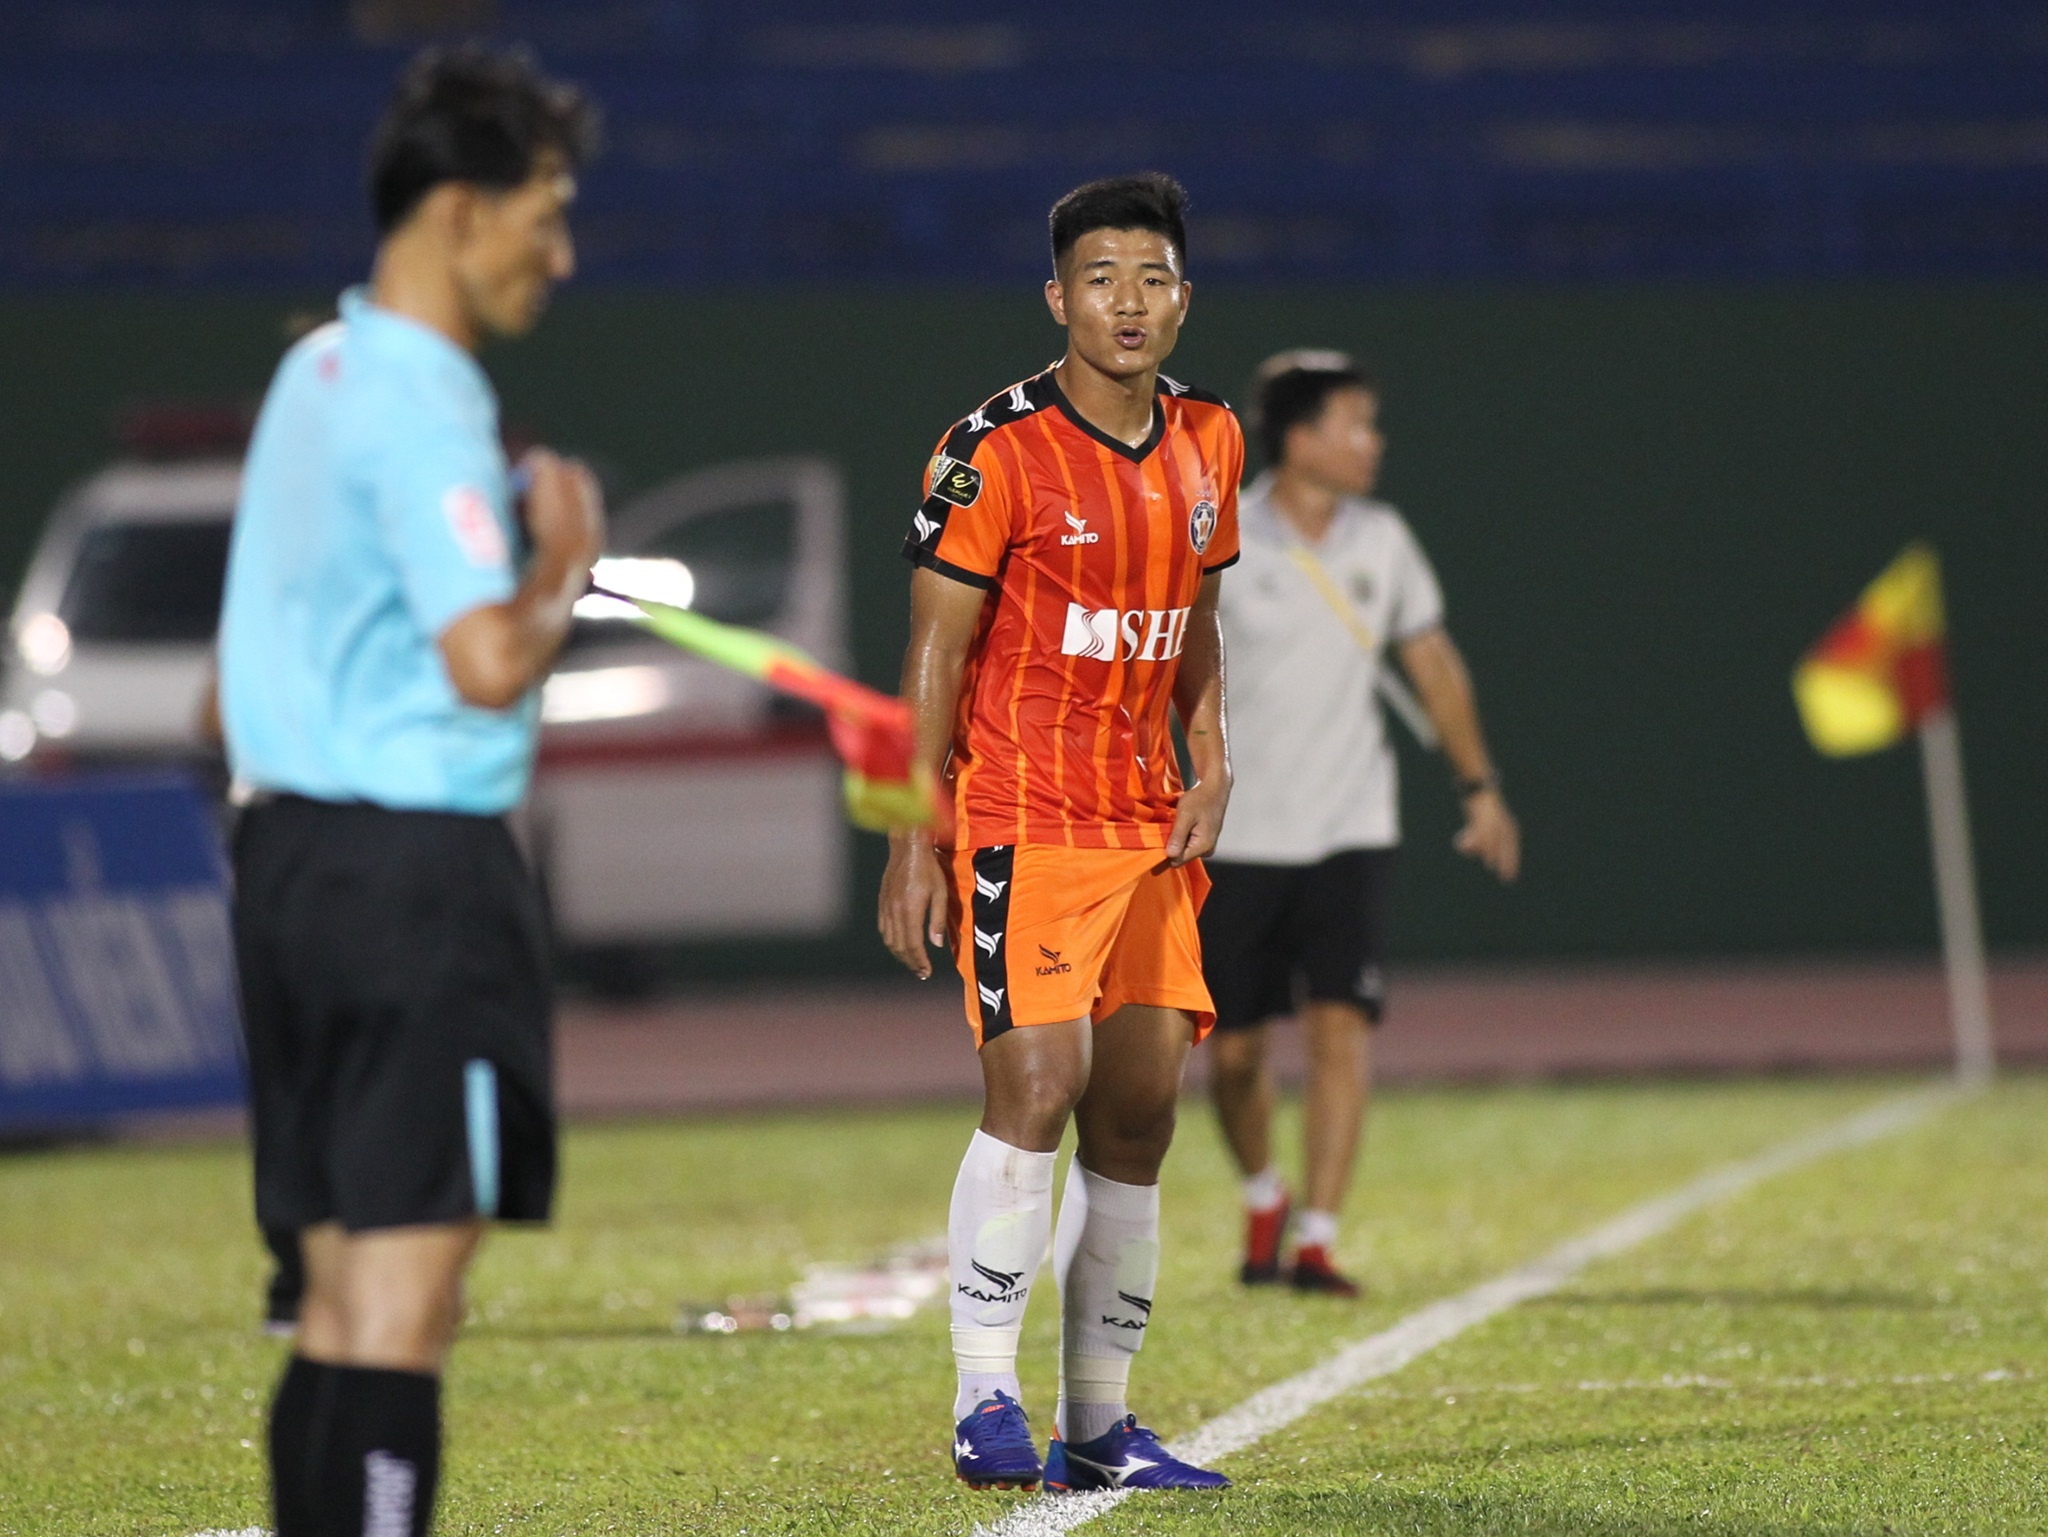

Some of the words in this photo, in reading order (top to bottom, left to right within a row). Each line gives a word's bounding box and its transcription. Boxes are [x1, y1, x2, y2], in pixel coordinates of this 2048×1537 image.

[1060, 532, 1099, 546] KAMITO
[1035, 962, 1072, 977] KAMITO
[957, 1283, 1028, 1304] KAMITO
